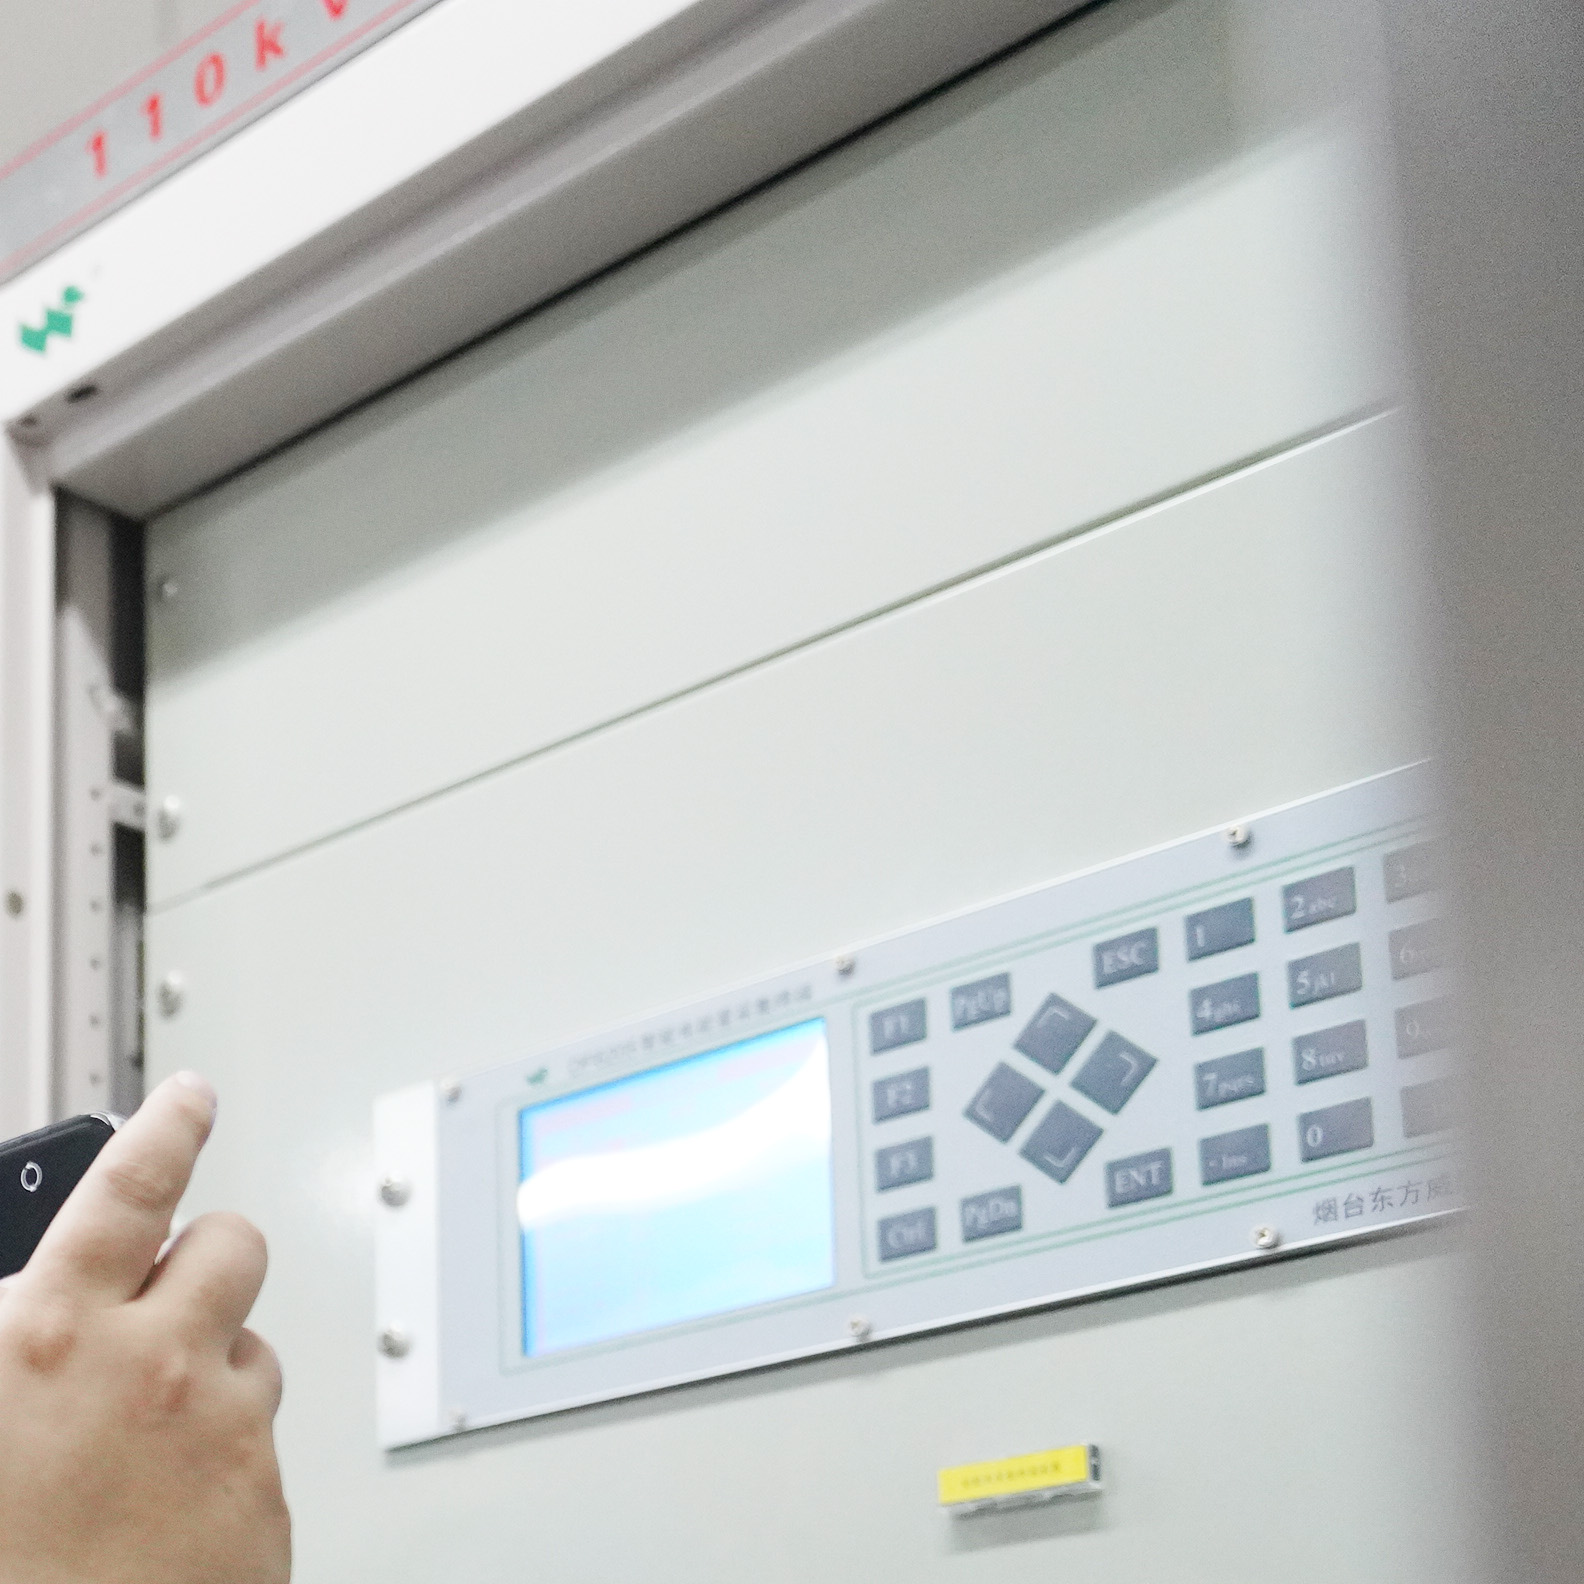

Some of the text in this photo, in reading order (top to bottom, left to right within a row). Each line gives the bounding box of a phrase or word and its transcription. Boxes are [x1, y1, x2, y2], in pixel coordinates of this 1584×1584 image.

[1290, 894, 1305, 920] 2
[1196, 923, 1206, 949] 1
[1102, 941, 1147, 975] ESC
[1296, 969, 1310, 995] 5
[1196, 998, 1212, 1018] 4
[883, 1013, 911, 1039] F1
[1302, 1048, 1317, 1071] 8
[886, 1081, 913, 1107] F2
[1203, 1072, 1218, 1097] 7
[1305, 1125, 1323, 1148] 0
[890, 1150, 918, 1179] F3
[1114, 1160, 1163, 1194] ENT
[964, 1197, 1019, 1230] PgDn
